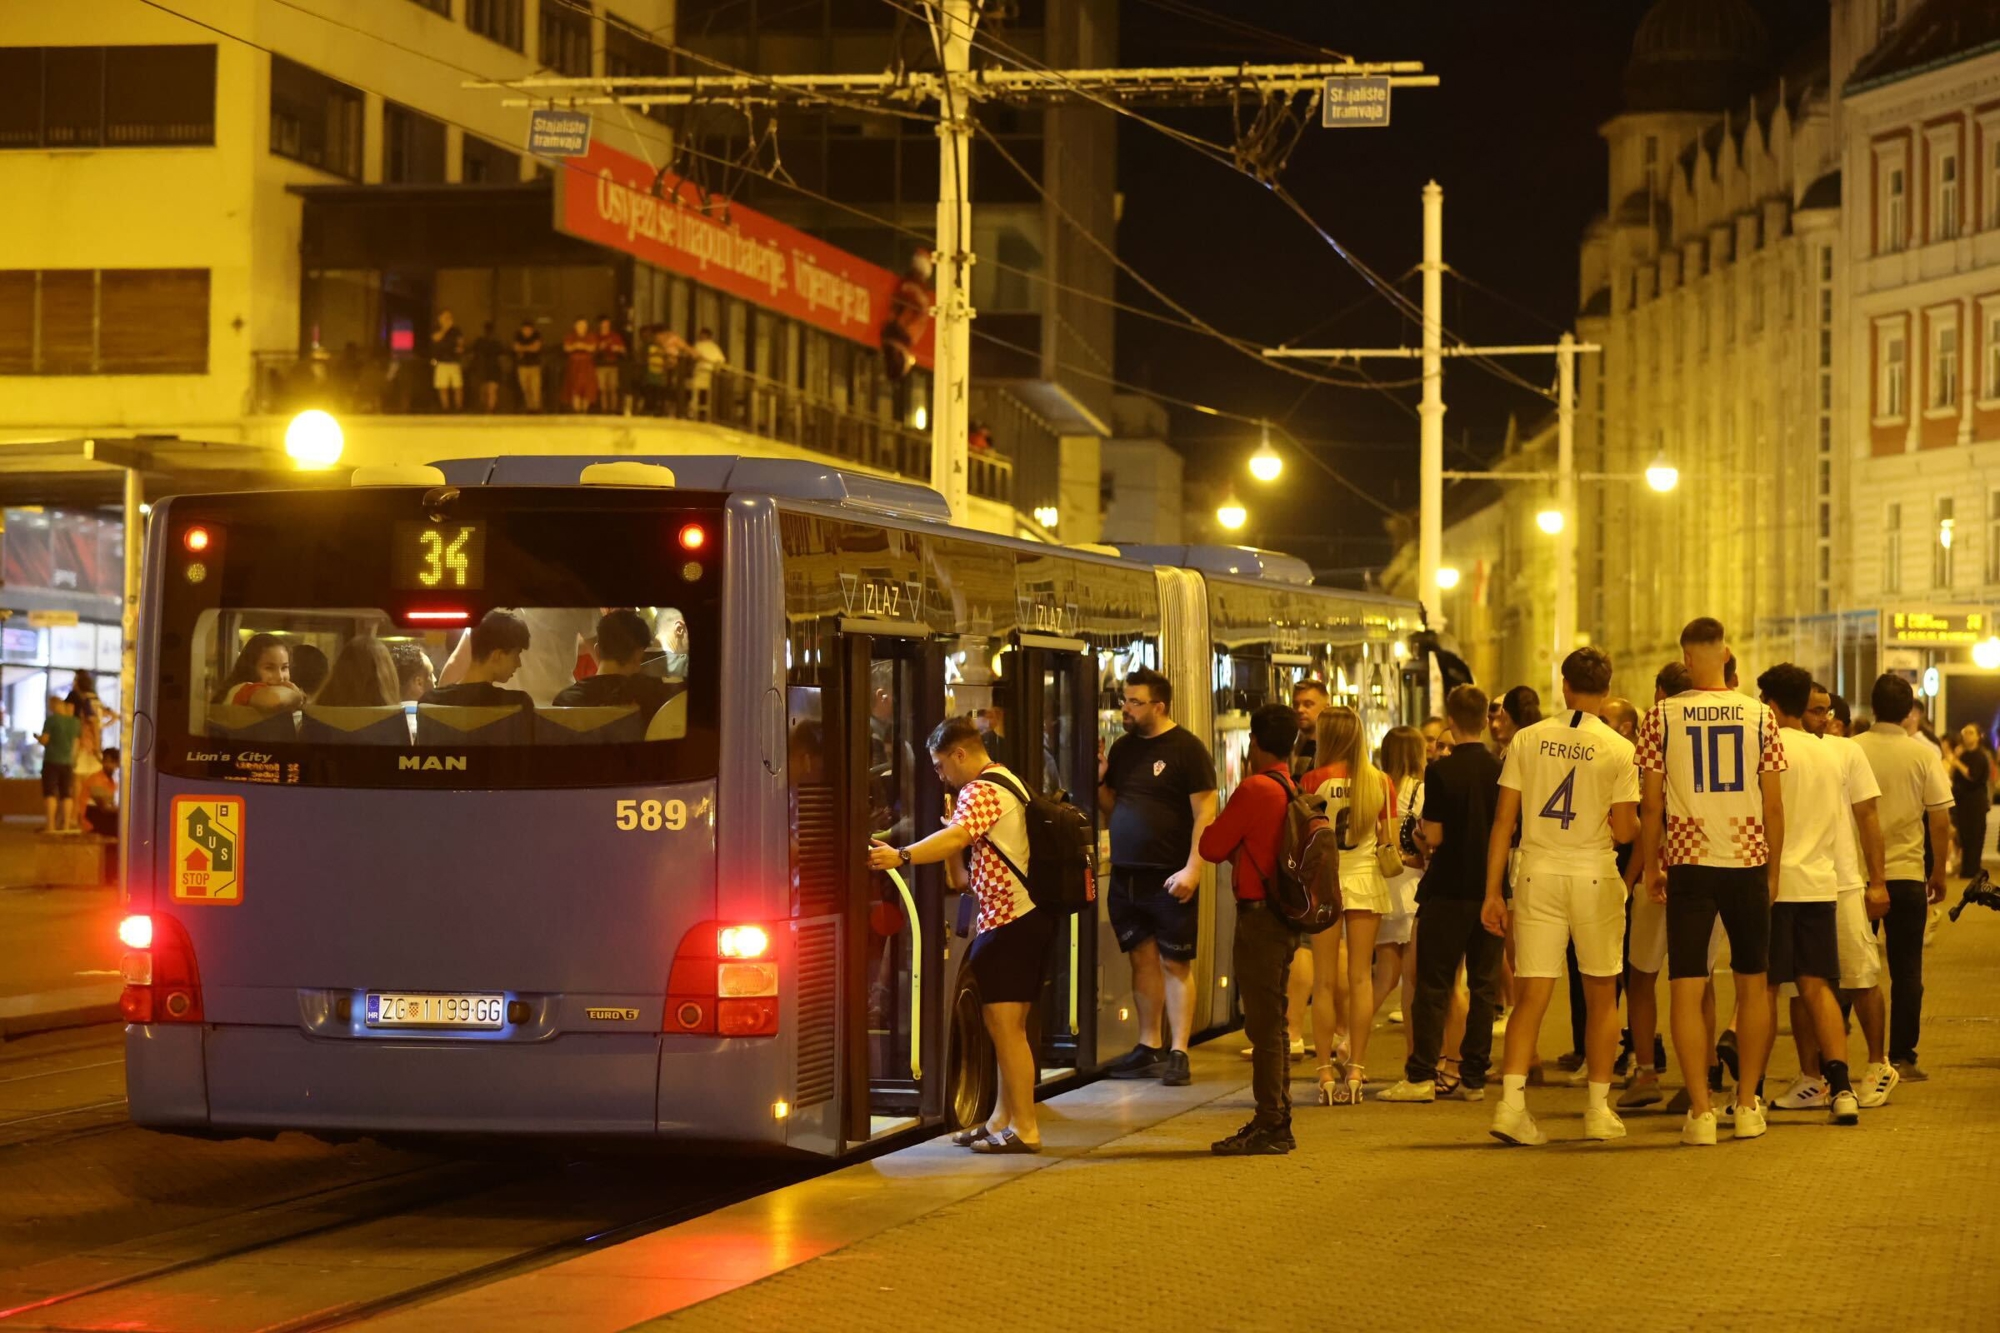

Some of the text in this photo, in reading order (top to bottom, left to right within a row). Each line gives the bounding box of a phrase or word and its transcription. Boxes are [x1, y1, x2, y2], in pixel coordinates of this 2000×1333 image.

[1332, 103, 1383, 121] tramvaja
[420, 530, 468, 585] 34
[863, 583, 900, 616] IZLAZ
[1035, 603, 1063, 633] IZLAZ
[1683, 703, 1744, 721] MODRIĆ
[186, 751, 272, 763] Lion's City
[1540, 740, 1595, 761] PERIŠIĆ
[1686, 725, 1744, 793] 10
[398, 755, 467, 770] MAN
[1538, 765, 1577, 830] 4
[616, 799, 687, 831] 589
[196, 824, 228, 860] BUS
[182, 872, 210, 886] STOP
[367, 1011, 378, 1019] HR
[382, 998, 405, 1020] ZG
[589, 1011, 620, 1019] EURO
